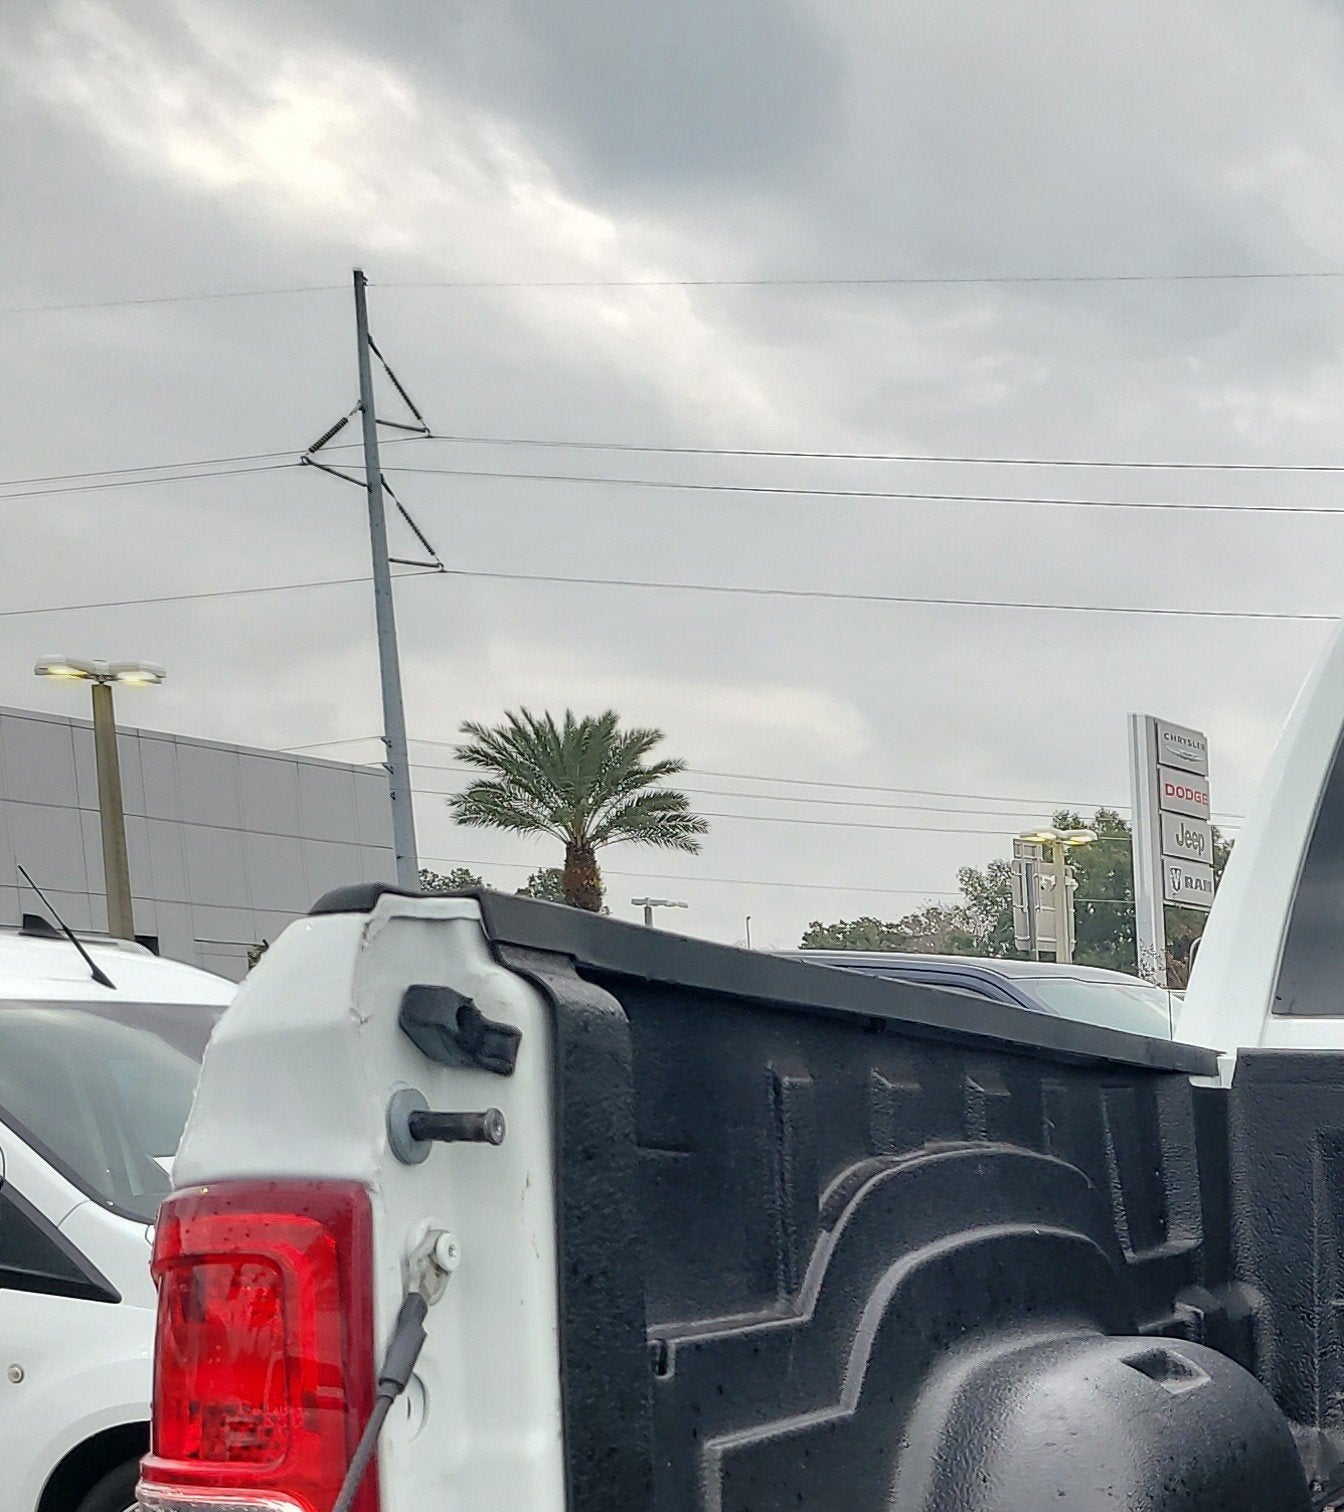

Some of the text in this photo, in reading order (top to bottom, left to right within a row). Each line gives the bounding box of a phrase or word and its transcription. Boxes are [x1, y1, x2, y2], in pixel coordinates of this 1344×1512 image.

[1165, 783, 1209, 806] DODGE
[1176, 822, 1205, 856] Jeep
[1184, 875, 1212, 893] RAM
